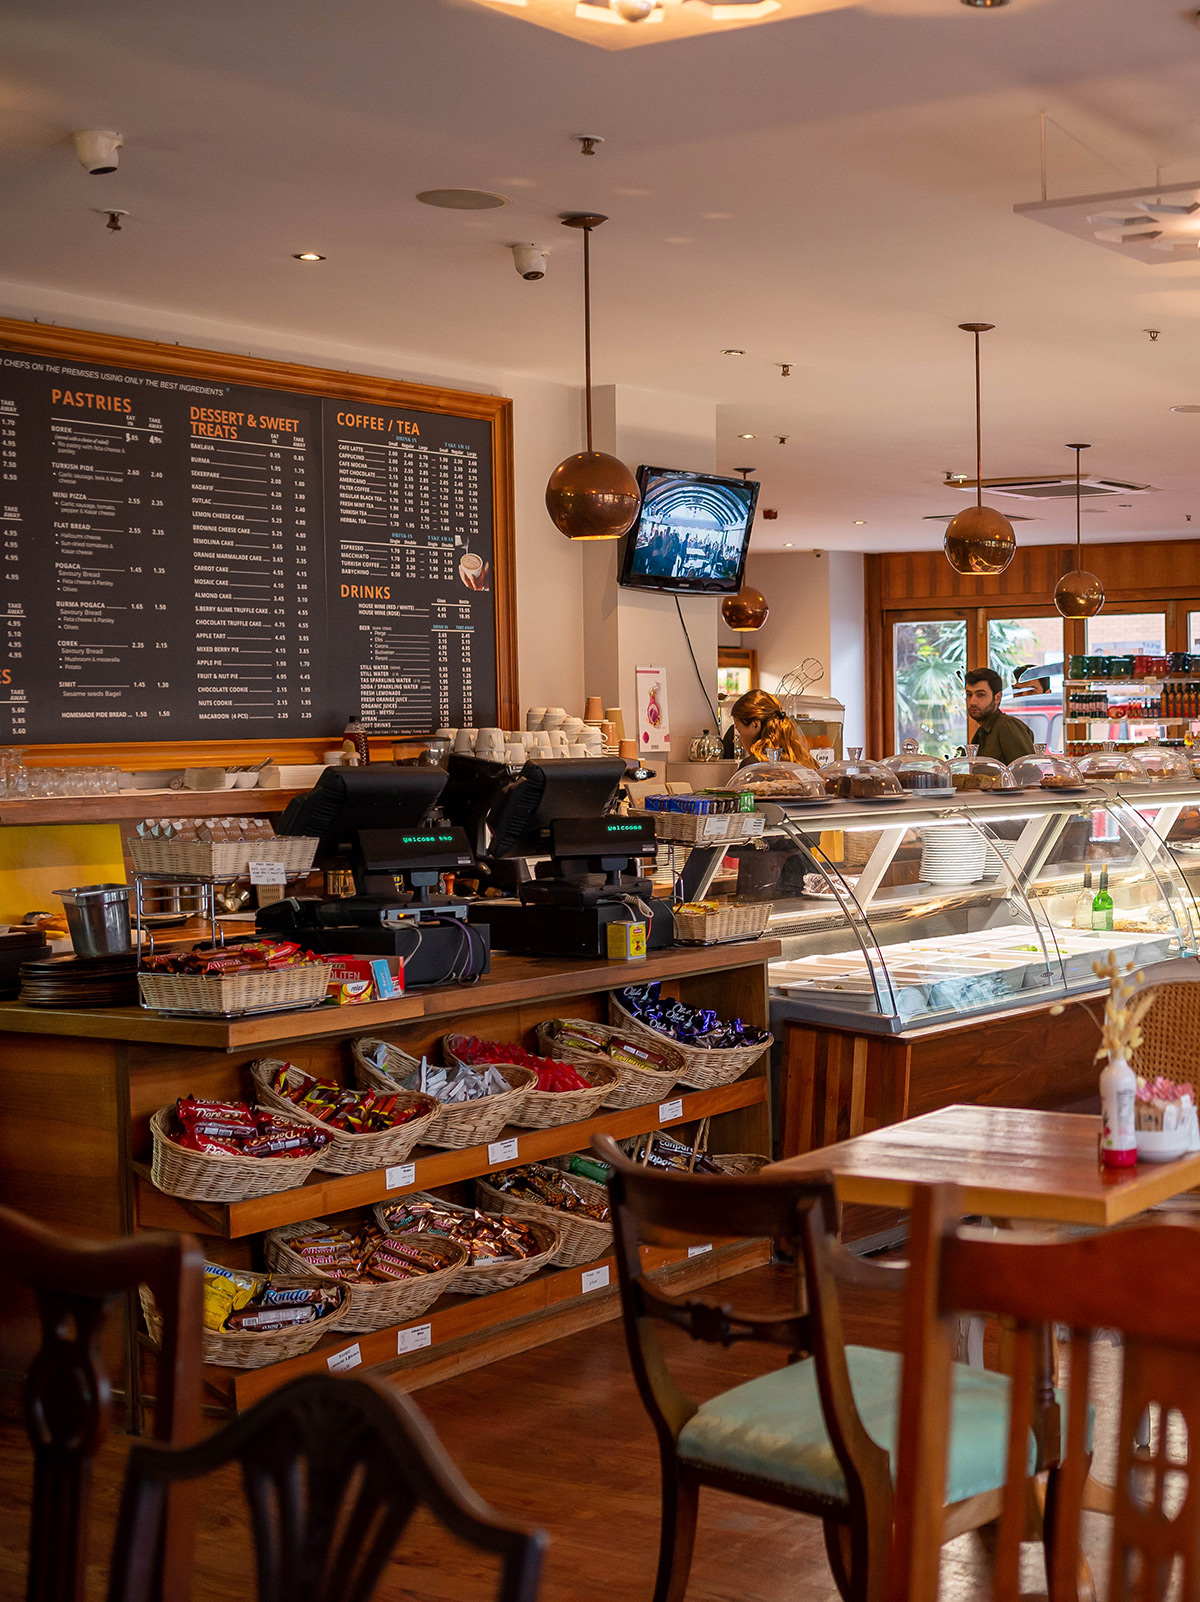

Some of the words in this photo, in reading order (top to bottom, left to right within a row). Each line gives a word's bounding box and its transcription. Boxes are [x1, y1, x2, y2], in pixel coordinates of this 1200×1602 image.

[3, 358, 31, 370] CHEFS
[32, 362, 44, 372] ON
[45, 364, 60, 374] THE
[62, 367, 99, 380] PREMISES
[101, 372, 124, 383] USING
[124, 374, 145, 386] ONLY
[145, 378, 159, 388] THE
[160, 380, 178, 390] BEST
[179, 383, 224, 397] INGREDIENTS
[51, 388, 132, 413] PASTRIES
[190, 406, 245, 426] DESSERT
[247, 414, 257, 428] &
[259, 415, 299, 433] SWEET
[337, 412, 384, 431] COFFEE
[388, 419, 393, 432] /
[396, 420, 420, 436] TEA
[190, 421, 238, 440] TREATS
[190, 443, 215, 451] BAKLAVA
[191, 456, 211, 464] BURMA
[338, 452, 365, 461] CAPPUCINO
[51, 462, 78, 471] TURKISH
[79, 464, 94, 472] PIDE
[350, 461, 368, 469] MOCHA
[127, 469, 140, 477] 2.60
[150, 471, 163, 479] 2.40
[191, 470, 220, 479] SEKERPARE
[349, 469, 376, 478] CHOCOLATE
[339, 477, 366, 485] AMERICANO
[52, 491, 68, 500] MINI
[69, 492, 87, 501] PIZZA
[127, 497, 141, 505] 2.55
[151, 499, 164, 507] 2.35
[192, 497, 212, 505] SUTLAC
[212, 512, 231, 520] CHEESE
[231, 513, 245, 521] CAKE
[54, 521, 69, 530] FLAT
[70, 523, 91, 531] BREAD
[192, 524, 217, 532] BROWNIE
[218, 526, 237, 534] CHEESE
[237, 527, 251, 535] CAKE
[193, 538, 220, 546] SEMOLINA
[193, 551, 216, 559] ORANGE
[216, 553, 249, 561] MARMALADE
[55, 562, 81, 570] POGACA
[129, 566, 143, 574] 1.45
[194, 578, 215, 586] MOSAIC
[340, 584, 391, 600] DRINKS
[79, 601, 106, 609] POGACA
[195, 605, 216, 613] S.BERRY
[105, 690, 122, 698] Bagel
[382, 1239, 420, 1257] Albeni
[305, 1255, 334, 1265] lbeni
[373, 1251, 409, 1268] Albeni
[202, 1265, 234, 1279] ondo
[265, 1288, 310, 1304] Rondo
